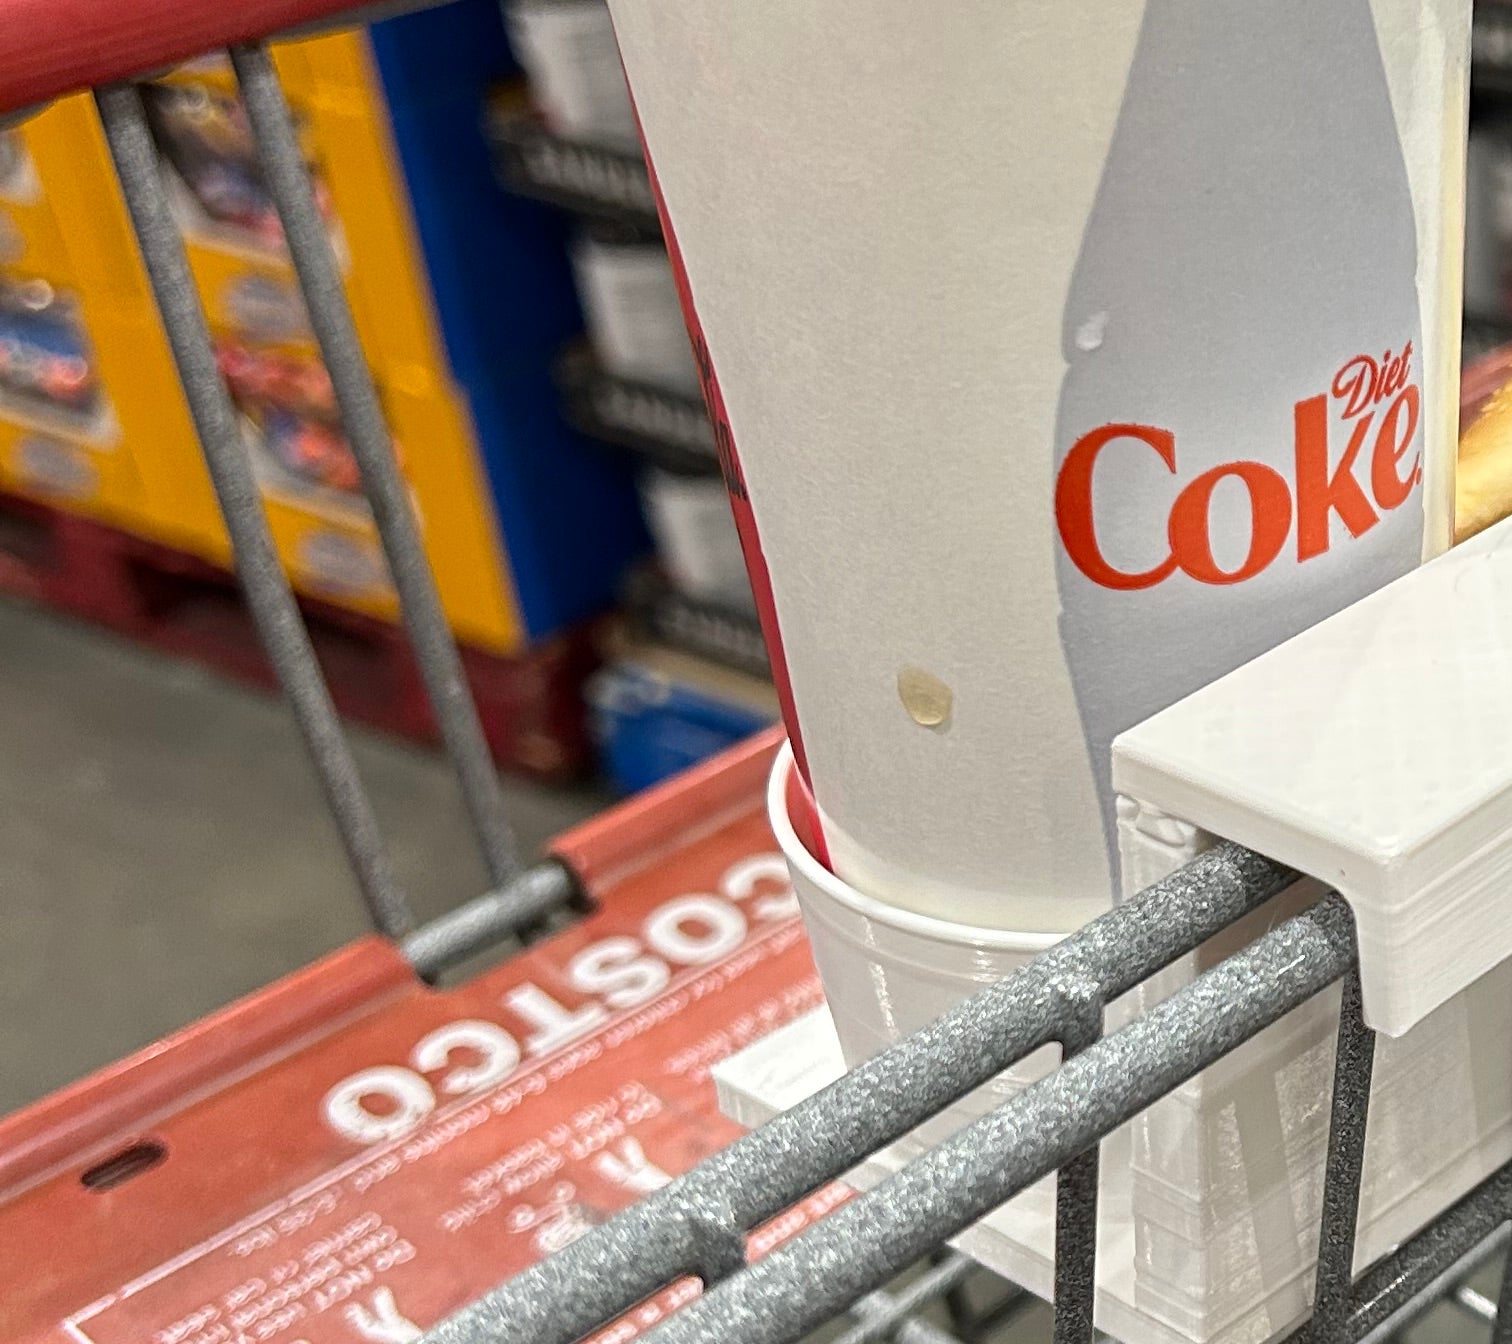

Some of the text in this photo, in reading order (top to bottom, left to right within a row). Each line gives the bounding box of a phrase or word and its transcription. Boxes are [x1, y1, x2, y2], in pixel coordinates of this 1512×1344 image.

[1331, 338, 1414, 420] Diet
[1054, 383, 1422, 592] Coke
[324, 852, 800, 1144] COSTCO
[307, 1260, 376, 1313] NOT
[368, 1234, 418, 1277] Do
